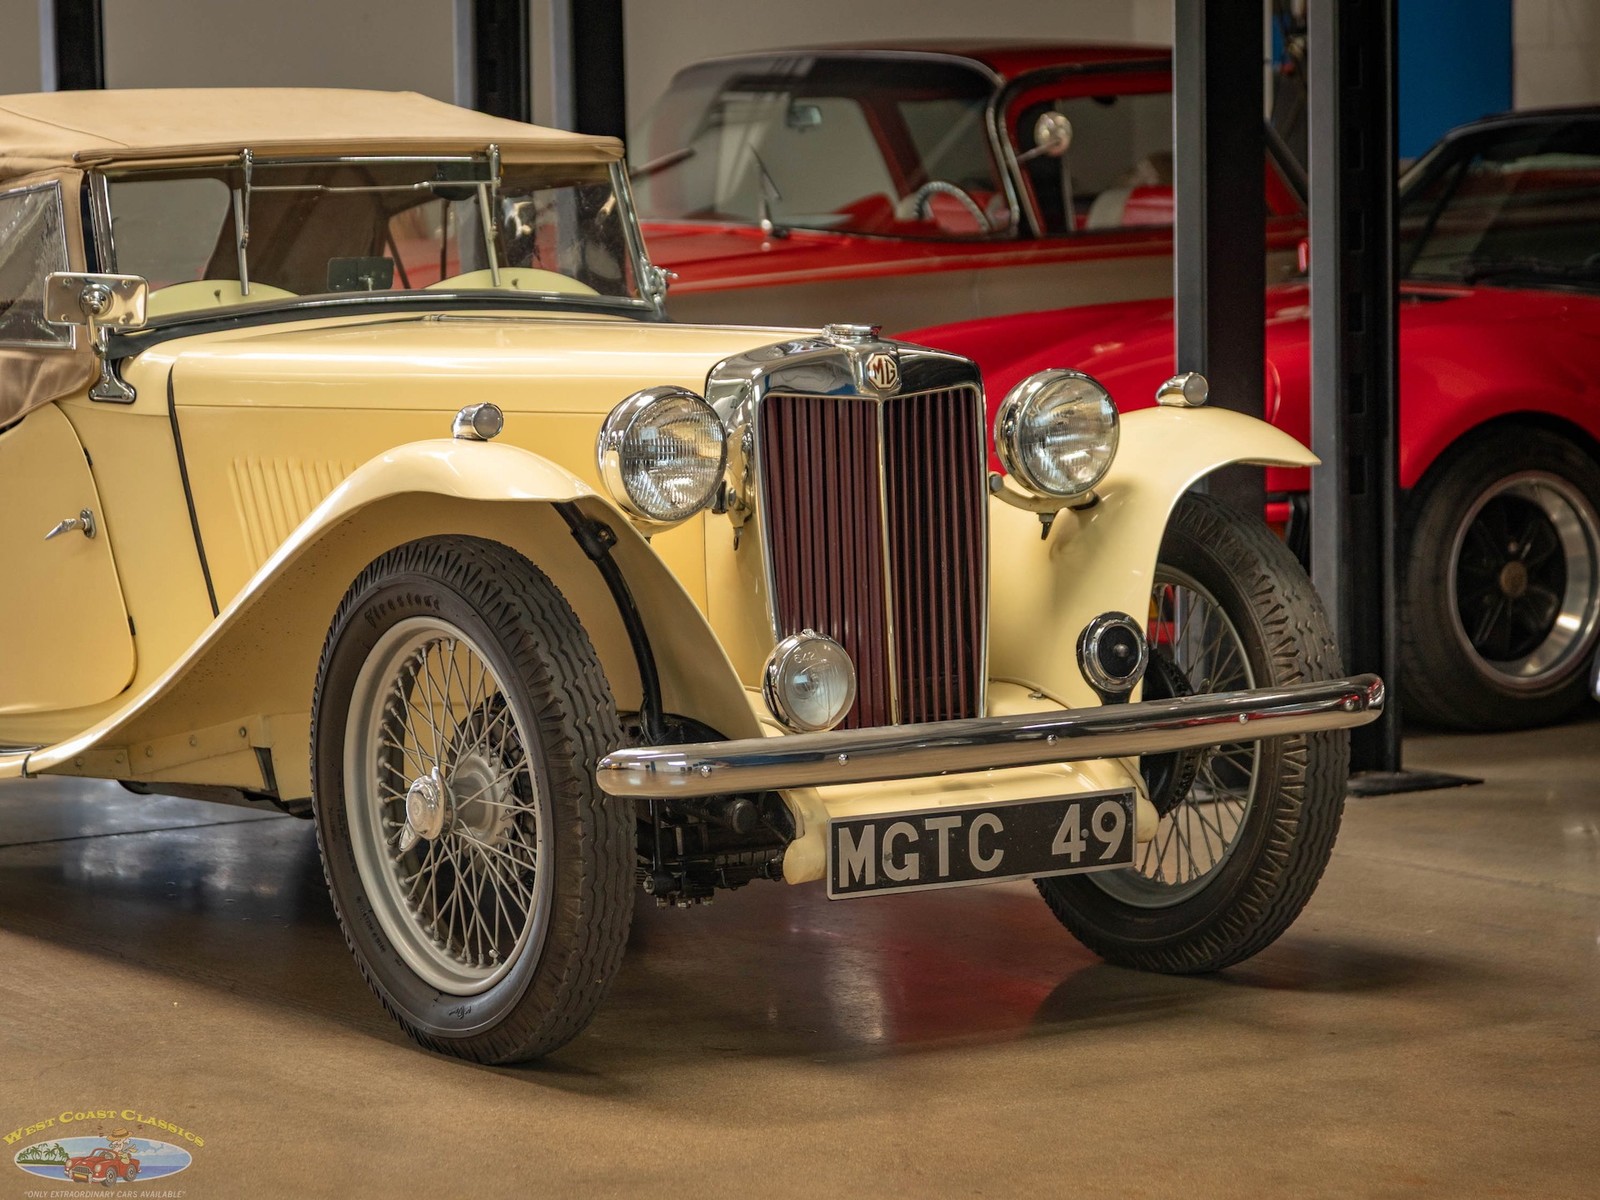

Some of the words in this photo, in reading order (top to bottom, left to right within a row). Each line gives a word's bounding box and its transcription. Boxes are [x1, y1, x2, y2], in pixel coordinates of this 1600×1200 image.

[872, 357, 896, 385] MG
[838, 812, 1004, 888] MGTC
[1051, 800, 1126, 863] 49
